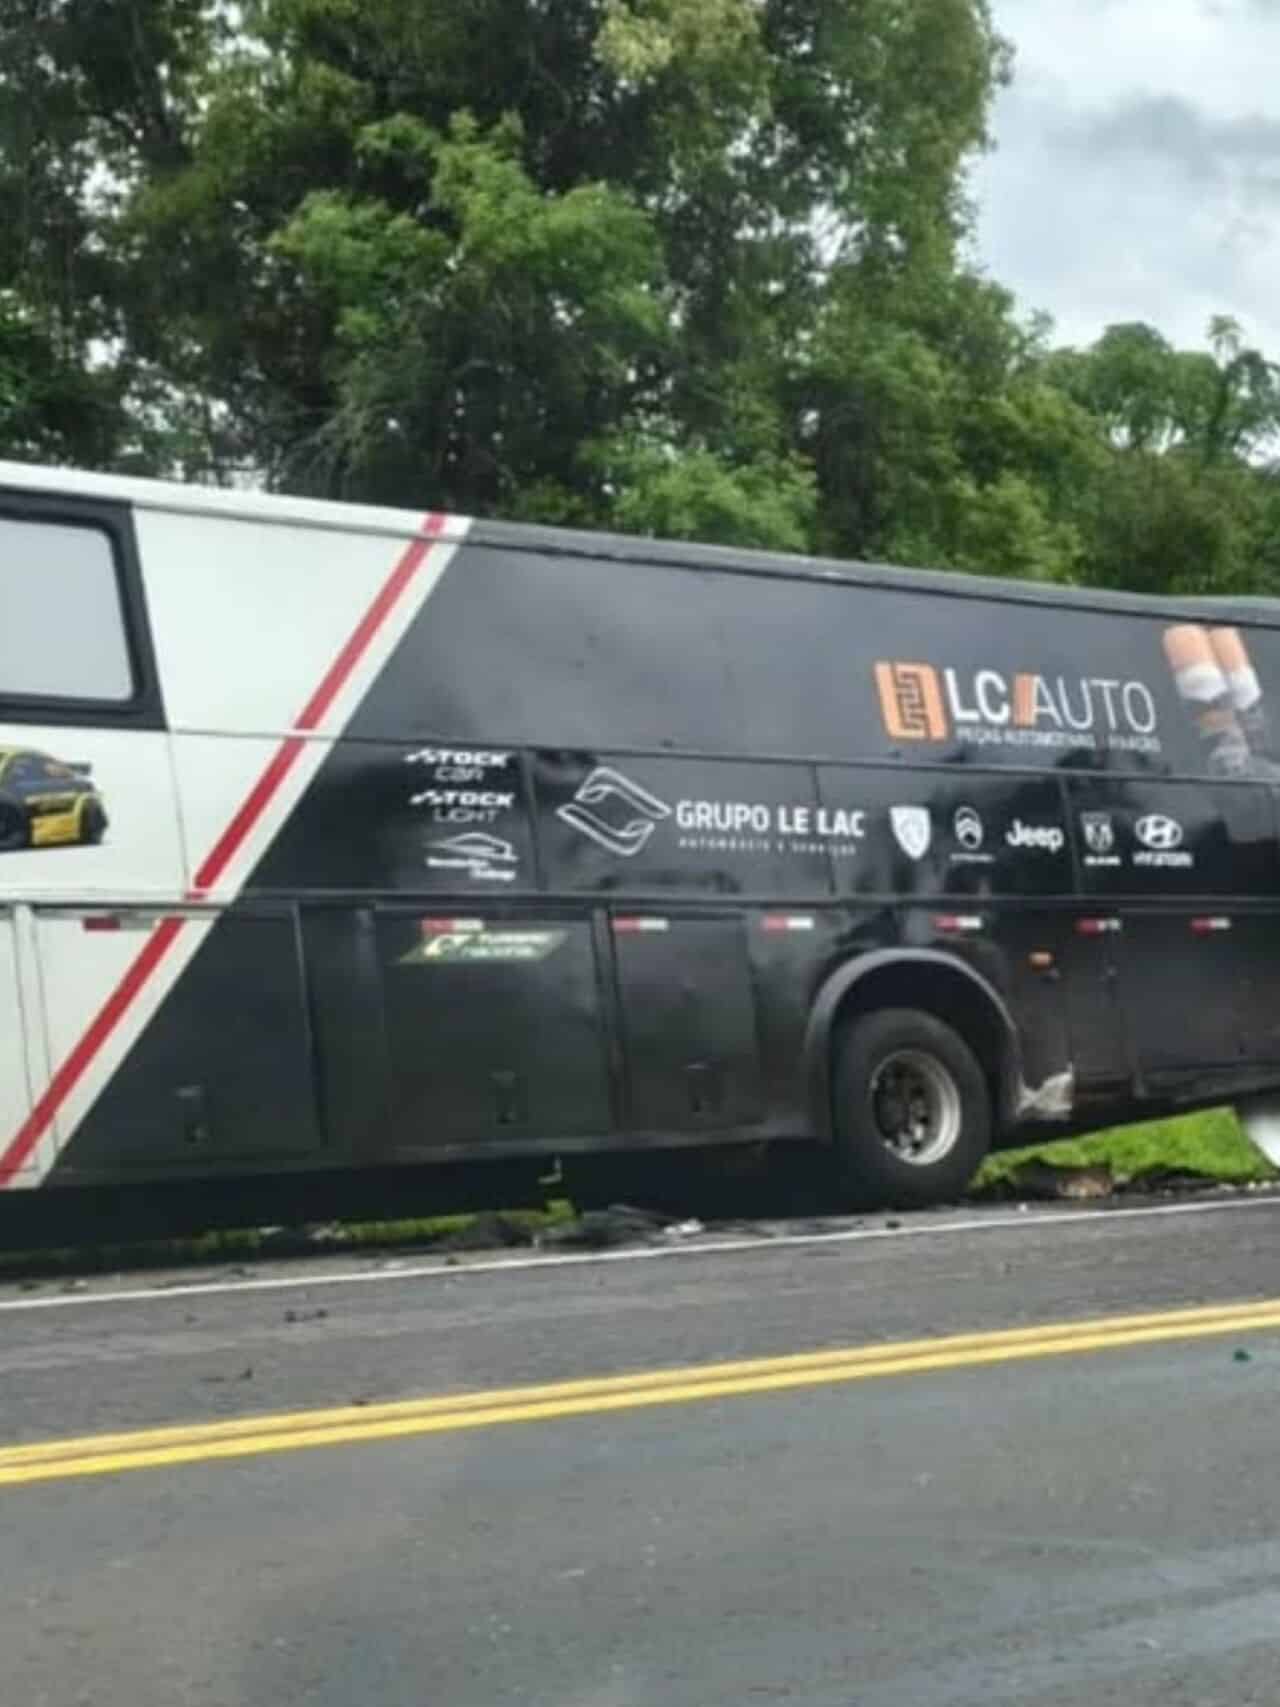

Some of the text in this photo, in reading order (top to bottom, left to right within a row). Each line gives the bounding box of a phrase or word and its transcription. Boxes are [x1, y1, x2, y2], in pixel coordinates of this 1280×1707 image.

[676, 800, 866, 837] GRUPO LE LAC
[1005, 819, 1064, 853] Jeep
